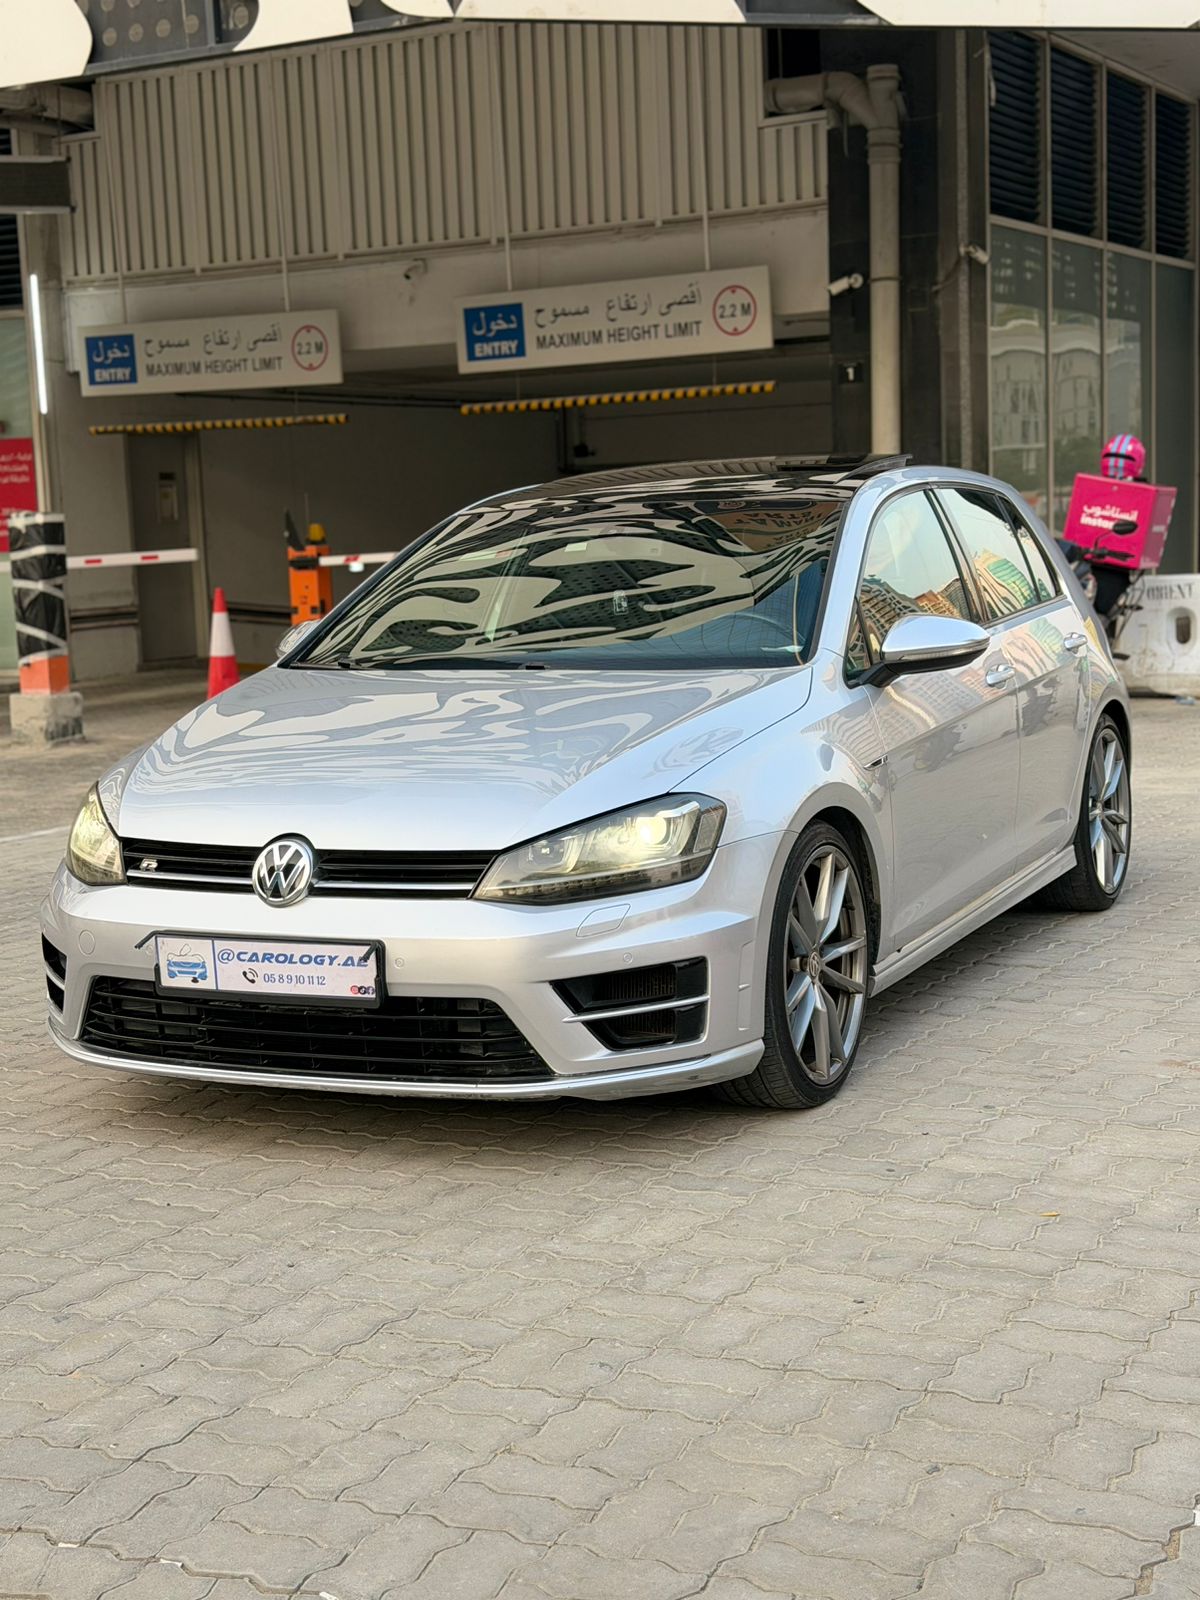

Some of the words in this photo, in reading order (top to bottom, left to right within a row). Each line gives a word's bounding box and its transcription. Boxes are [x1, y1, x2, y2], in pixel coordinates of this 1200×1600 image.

[534, 306, 589, 328] مسموح
[719, 304, 737, 319] 2.2
[740, 302, 752, 316] M
[472, 311, 518, 337] دخول
[536, 329, 604, 350] MAXIMUM
[607, 325, 660, 343] HEIGHT
[664, 321, 703, 338] LIMIT
[92, 340, 131, 364] دخول
[296, 342, 313, 356] 2.2
[314, 341, 324, 354] M
[474, 340, 519, 357] ENTRY
[94, 368, 131, 383] ENTRY
[145, 361, 201, 377] MAXIMUM
[204, 358, 250, 374] HEIGHT
[253, 357, 283, 372] LIMIT
